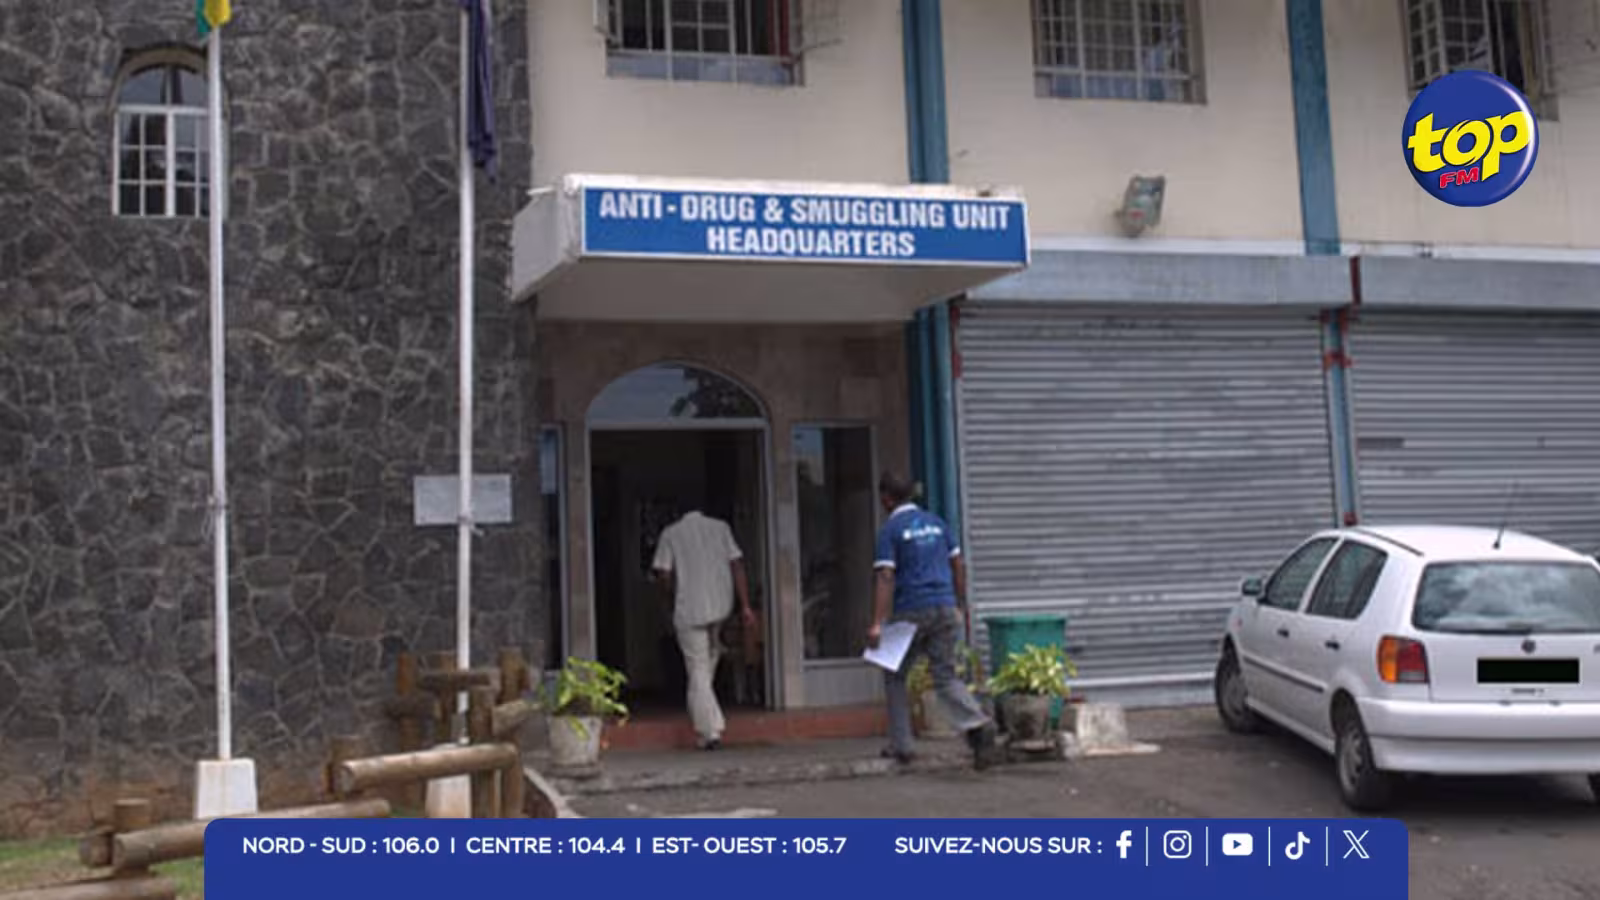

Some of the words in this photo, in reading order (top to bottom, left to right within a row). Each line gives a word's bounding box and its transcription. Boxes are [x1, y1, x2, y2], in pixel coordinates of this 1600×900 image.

[600, 191, 663, 219] ANTI
[681, 194, 756, 223] DRUG
[763, 197, 784, 223] &
[790, 197, 947, 229] SMUGGLING
[952, 203, 1011, 231] UNIT
[706, 226, 916, 257] HEADQUARTERS
